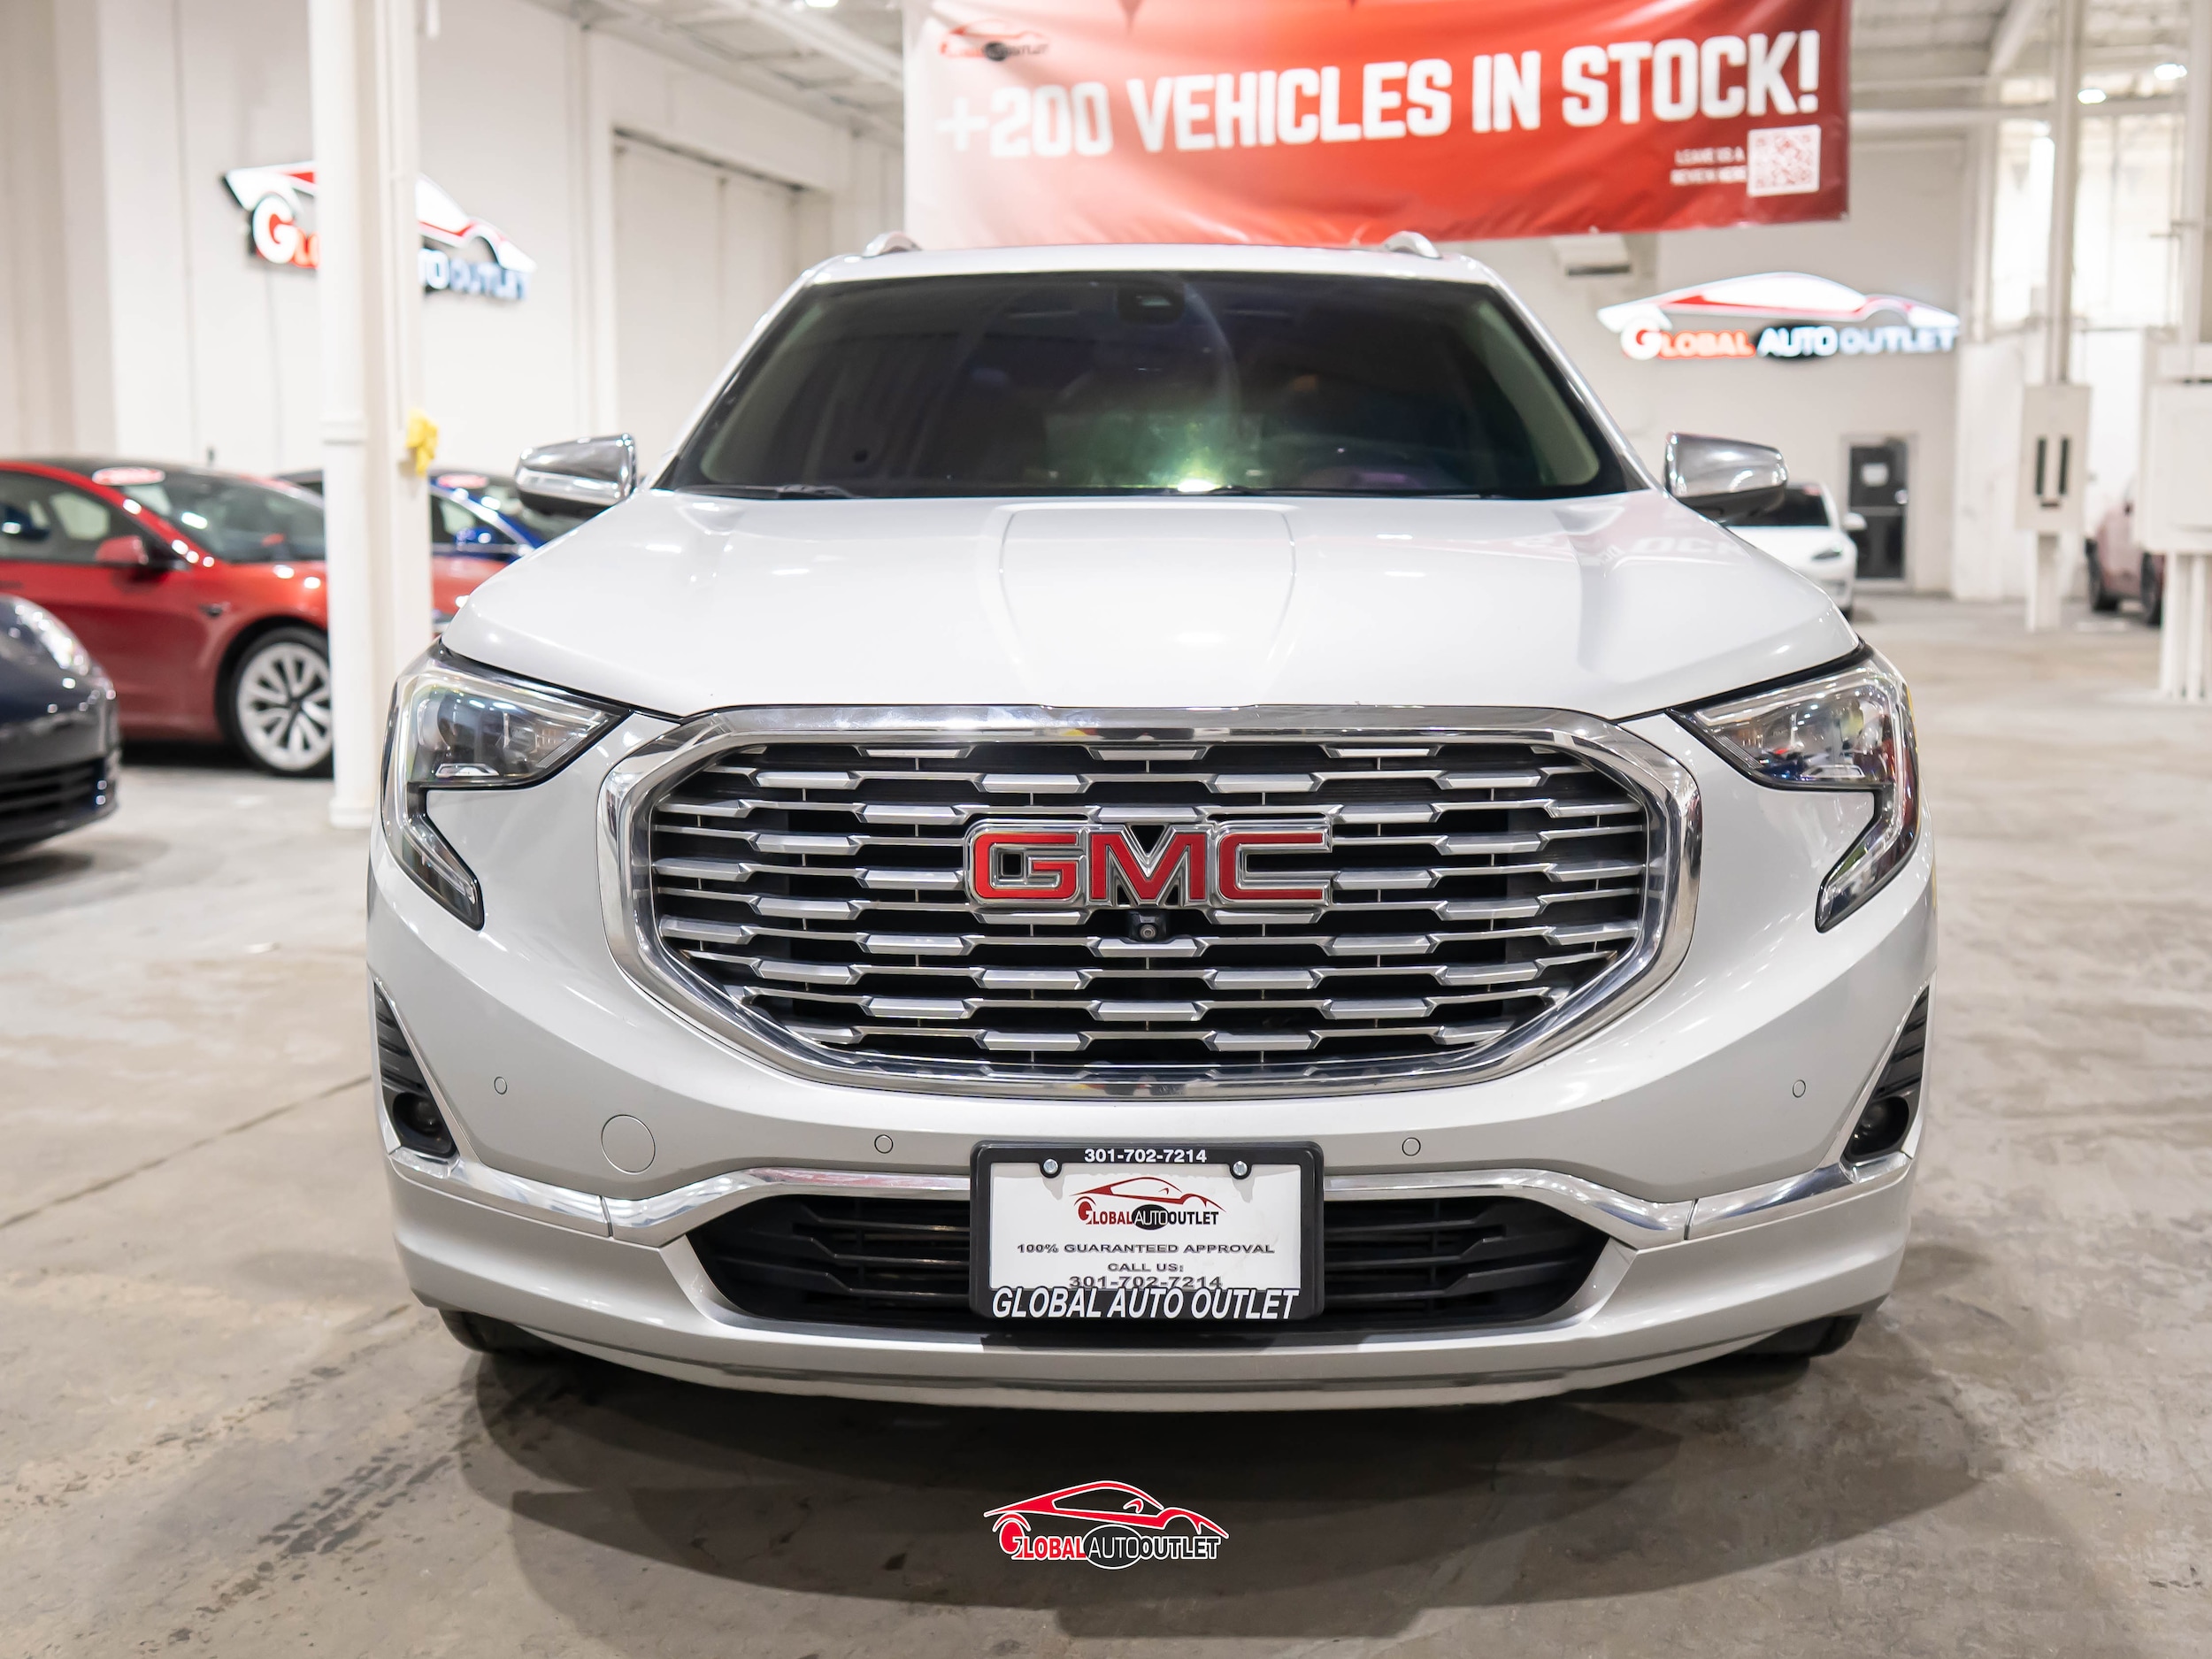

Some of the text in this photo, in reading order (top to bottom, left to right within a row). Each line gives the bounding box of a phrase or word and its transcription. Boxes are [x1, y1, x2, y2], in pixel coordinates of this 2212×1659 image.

[939, 30, 1820, 157] +200 VEHICLES IN STOCK!
[1621, 317, 1957, 360] GLOBAL AUTO OUTLET
[967, 821, 1331, 906] GMC
[1084, 1148, 1208, 1164] 301-702-7214
[1079, 1202, 1219, 1225] GLOBAL AUTO OUTLET
[1018, 1243, 1275, 1255] 100% GUARANTEED APPROVAL
[1107, 1262, 1184, 1273] CALL US:
[1068, 1275, 1223, 1289] 301-702-7214
[991, 1286, 1301, 1320] GLOBAL AUTO OUTLET
